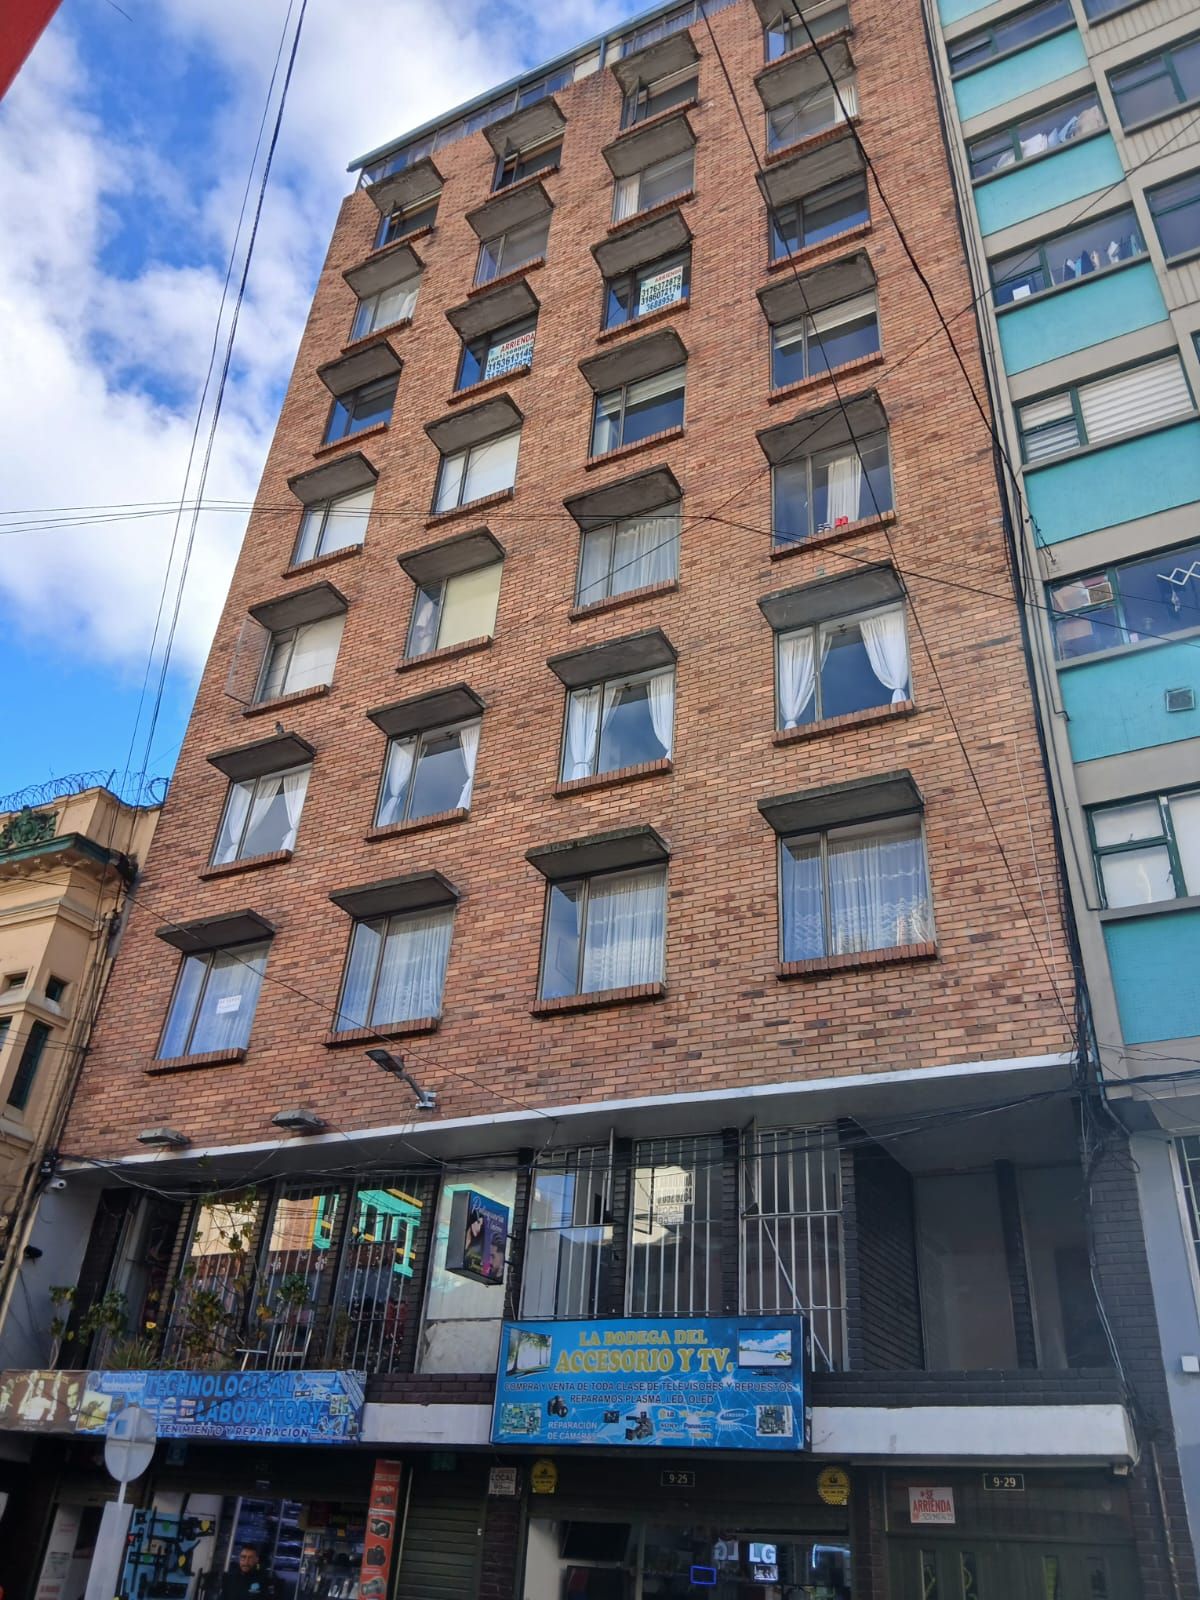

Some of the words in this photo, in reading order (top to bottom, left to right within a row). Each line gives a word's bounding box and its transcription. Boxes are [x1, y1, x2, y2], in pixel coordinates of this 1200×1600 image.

[500, 332, 535, 352] ARRIENDA
[578, 1330, 601, 1346] LA
[603, 1329, 671, 1346] BODEGA
[674, 1329, 708, 1345] DEL
[554, 1348, 674, 1373] ACCESORIO
[677, 1348, 695, 1372] Y
[145, 1374, 293, 1399] TECHNOLOGICAL
[504, 1382, 538, 1392] COMPRA
[538, 1382, 545, 1391] Y
[548, 1382, 575, 1391] VENTA
[577, 1382, 589, 1391] DE
[591, 1382, 613, 1391] TODA
[616, 1382, 646, 1391] CLASE
[647, 1382, 659, 1391] DE
[661, 1381, 724, 1391] TELEVISORES
[725, 1382, 733, 1391] Y
[735, 1381, 793, 1392] REPUESTOS
[570, 1395, 623, 1404] REPARAMOS
[688, 1395, 713, 1404] OLED
[196, 1400, 323, 1425] LABORATORY
[156, 1424, 223, 1437] TENIMIENTO
[225, 1426, 234, 1436] Y
[235, 1426, 309, 1438] REPARACION
[548, 1421, 597, 1430] REPARACION
[547, 1432, 558, 1440] DE
[993, 1477, 1016, 1488] 9-29
[913, 1499, 952, 1513] ARRIENDA
[749, 1542, 777, 1564] LG
